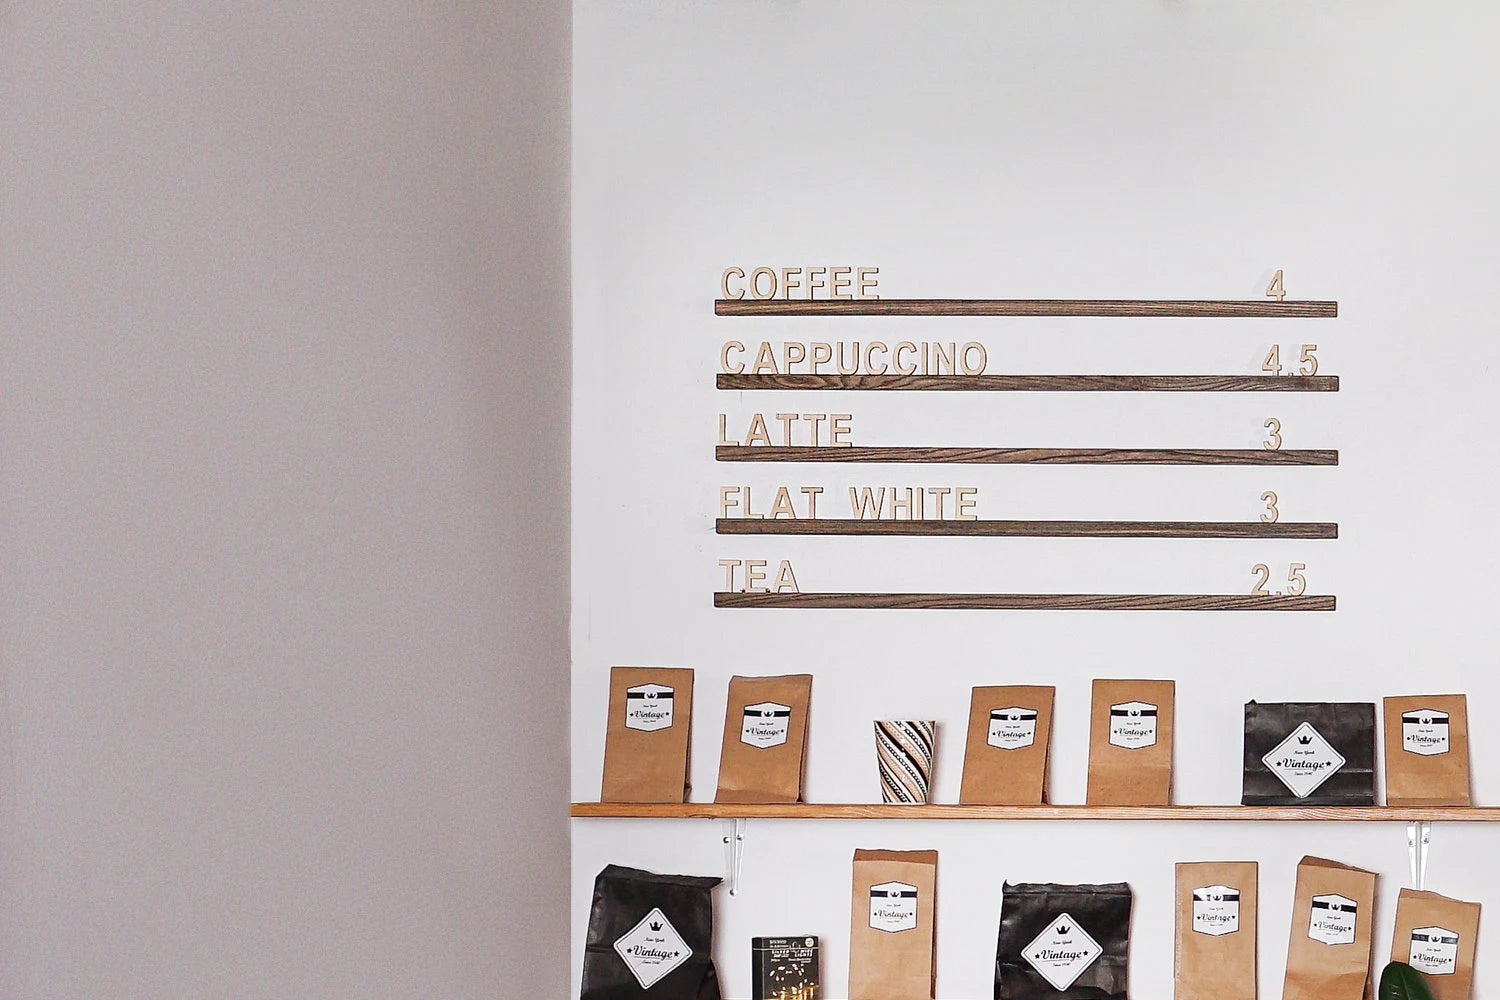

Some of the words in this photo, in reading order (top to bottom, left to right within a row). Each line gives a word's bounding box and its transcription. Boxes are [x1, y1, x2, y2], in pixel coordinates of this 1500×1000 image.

[720, 266, 880, 300] COFFEE
[1265, 269, 1286, 302] 4
[720, 340, 988, 376] CAPPUCCINO
[1260, 344, 1319, 377] 4.5
[719, 413, 853, 447] LATTE
[1262, 417, 1283, 451] 3
[720, 486, 825, 520] FLAT
[848, 486, 978, 521] WHITE
[1259, 490, 1280, 524] 3
[719, 559, 800, 594] TEA
[1250, 562, 1306, 597] 2.5
[634, 710, 664, 719] Vintage
[1118, 727, 1148, 736] Vintage
[1282, 758, 1325, 771] Vintage
[633, 945, 673, 960] Vintage
[1041, 950, 1081, 961] Vintage
